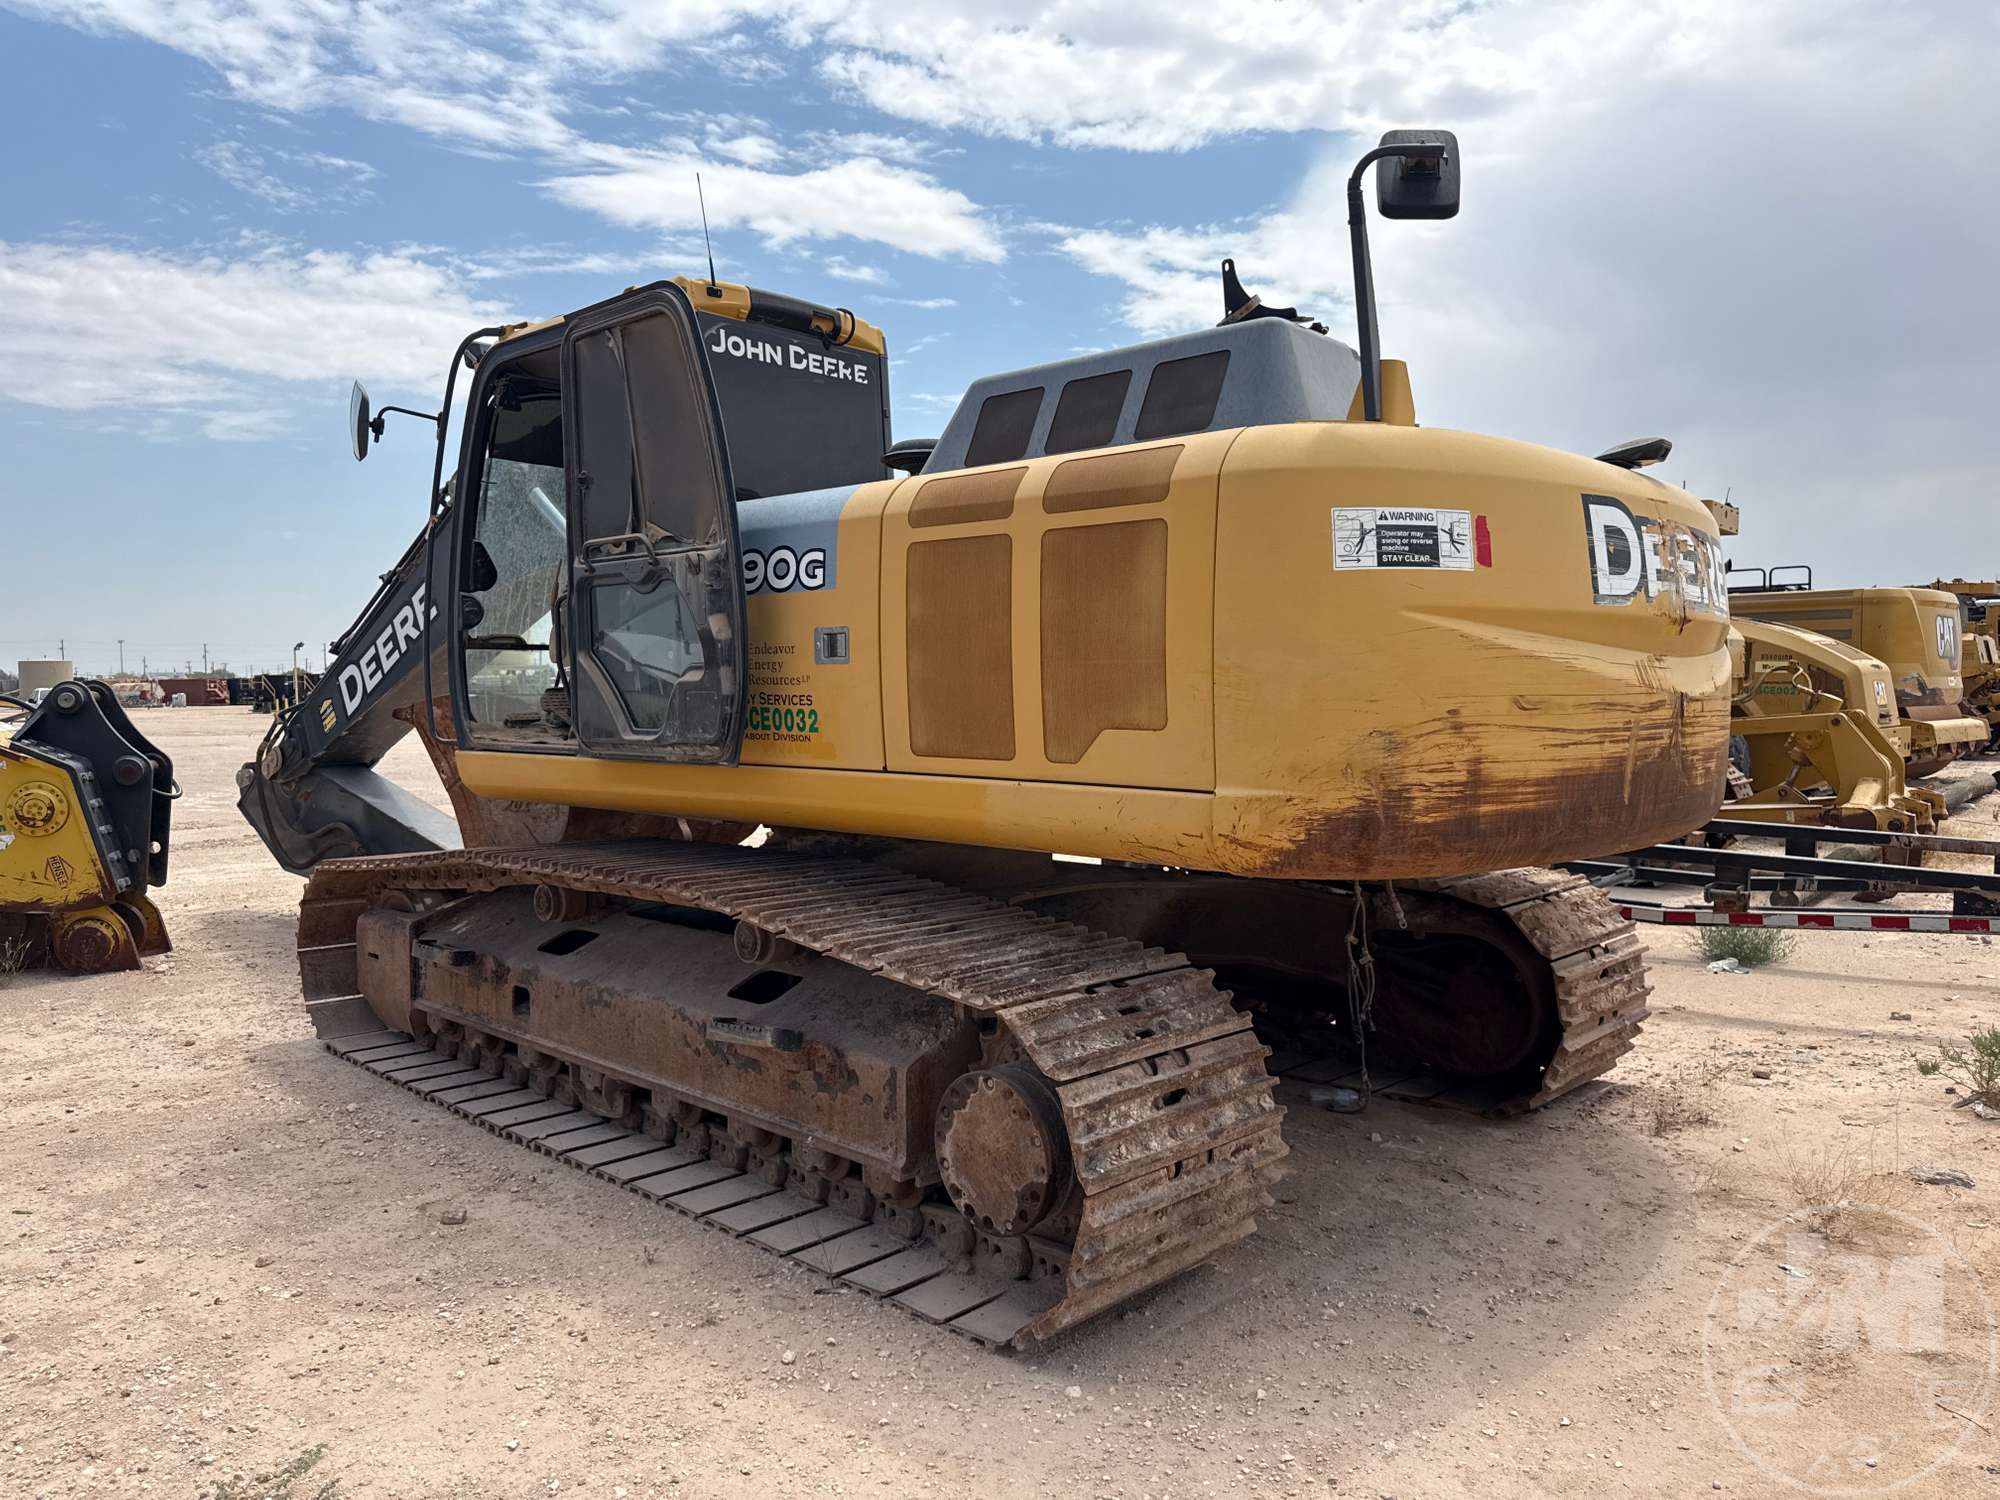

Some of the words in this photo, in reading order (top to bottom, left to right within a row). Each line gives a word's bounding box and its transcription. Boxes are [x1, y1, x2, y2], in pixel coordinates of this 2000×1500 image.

[711, 328, 783, 367] JOHN
[788, 344, 869, 384] DEERE
[1389, 511, 1434, 522] WARNING
[1381, 530, 1409, 538] Operator
[1381, 538, 1401, 546] swing
[1382, 554, 1402, 562] STAY
[1404, 554, 1431, 562] CLEAR
[1936, 615, 1955, 657] CAT
[338, 583, 438, 717] DEERE
[748, 674, 801, 686] Resources
[759, 692, 813, 706] SERVICES
[744, 707, 819, 733] CE0032
[773, 732, 811, 742] DIVISION
